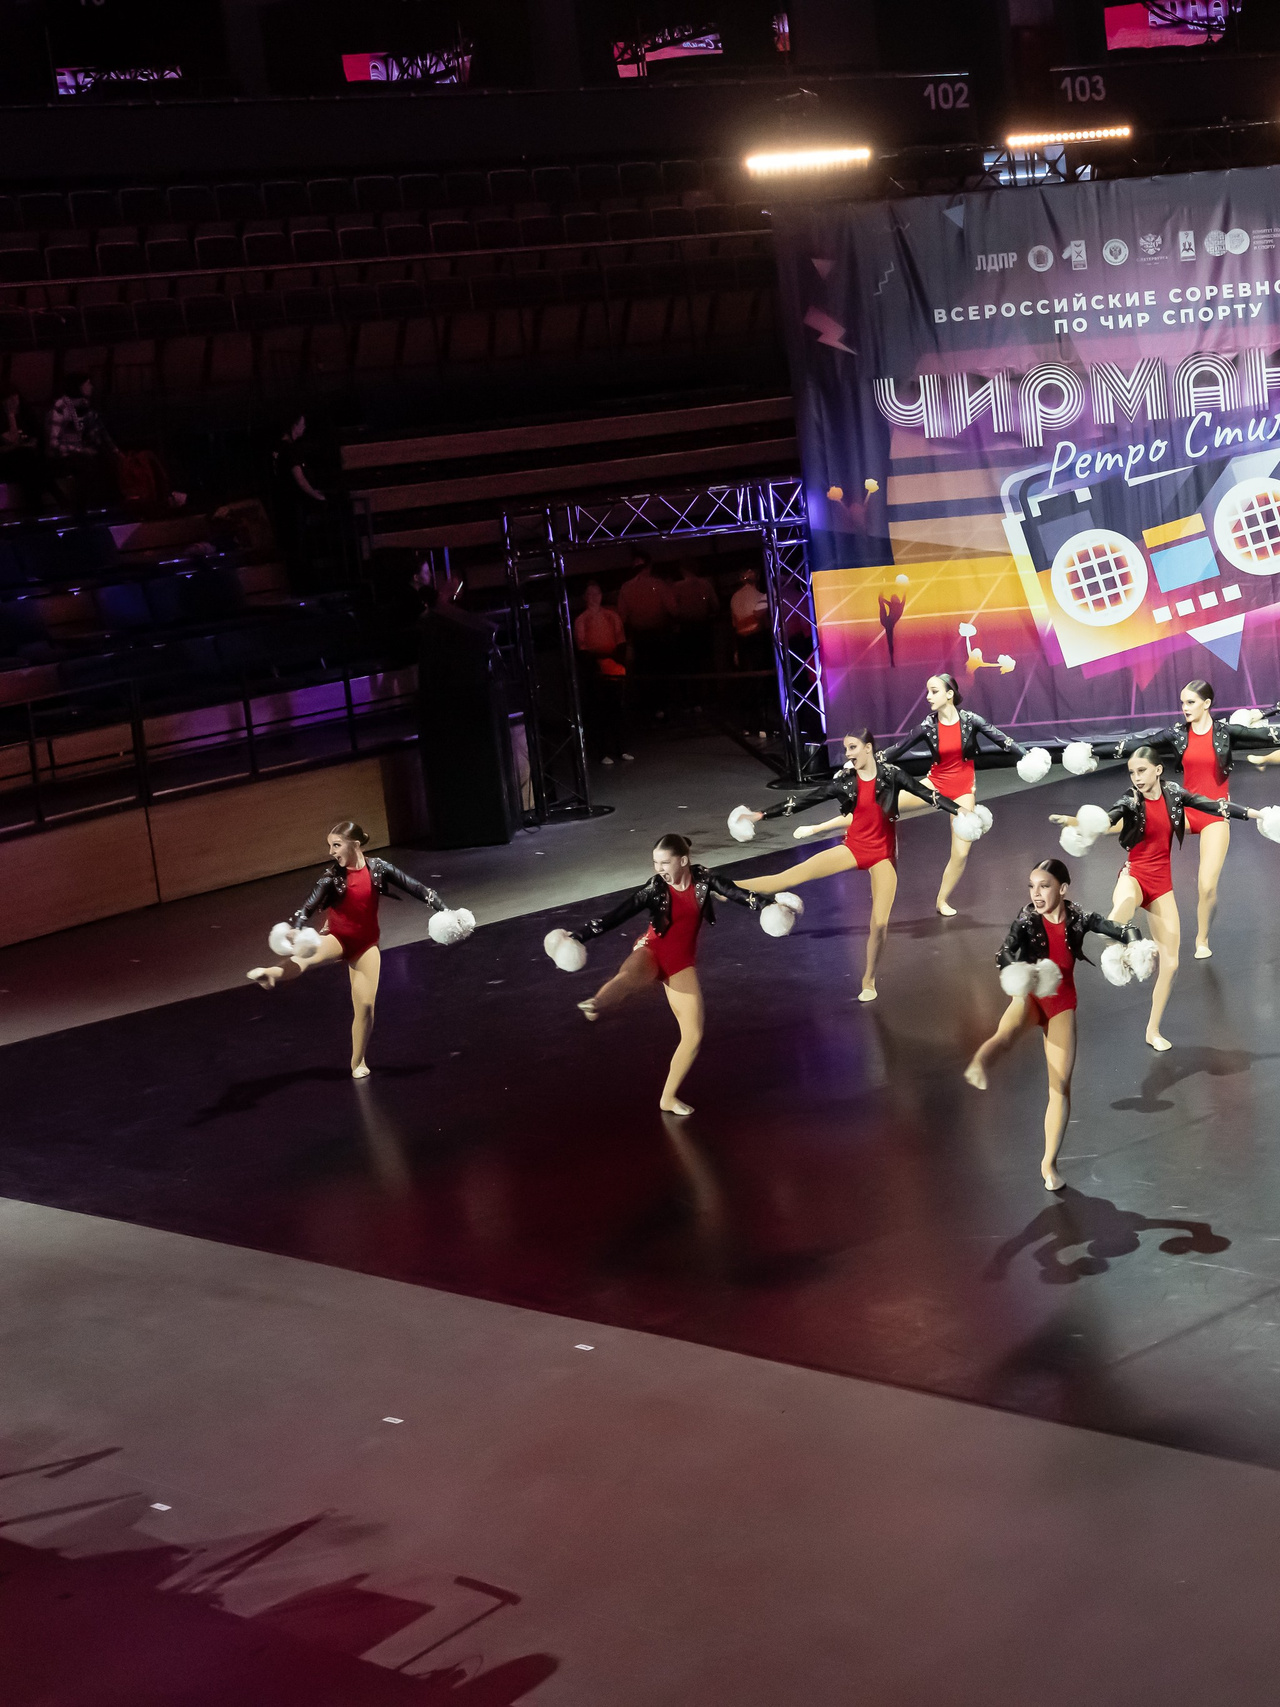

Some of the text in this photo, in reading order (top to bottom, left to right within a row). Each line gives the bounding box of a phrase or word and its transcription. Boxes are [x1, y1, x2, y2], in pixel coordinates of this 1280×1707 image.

[923, 82, 970, 110] 102
[1060, 75, 1106, 103] 103
[975, 252, 1018, 273] ЛДПР
[934, 290, 1157, 324] ВСЕРОССИЙСКИЕ
[1054, 302, 1263, 335] ПО ЧИР СПОРТУ
[1048, 441, 1169, 489] Ретро
